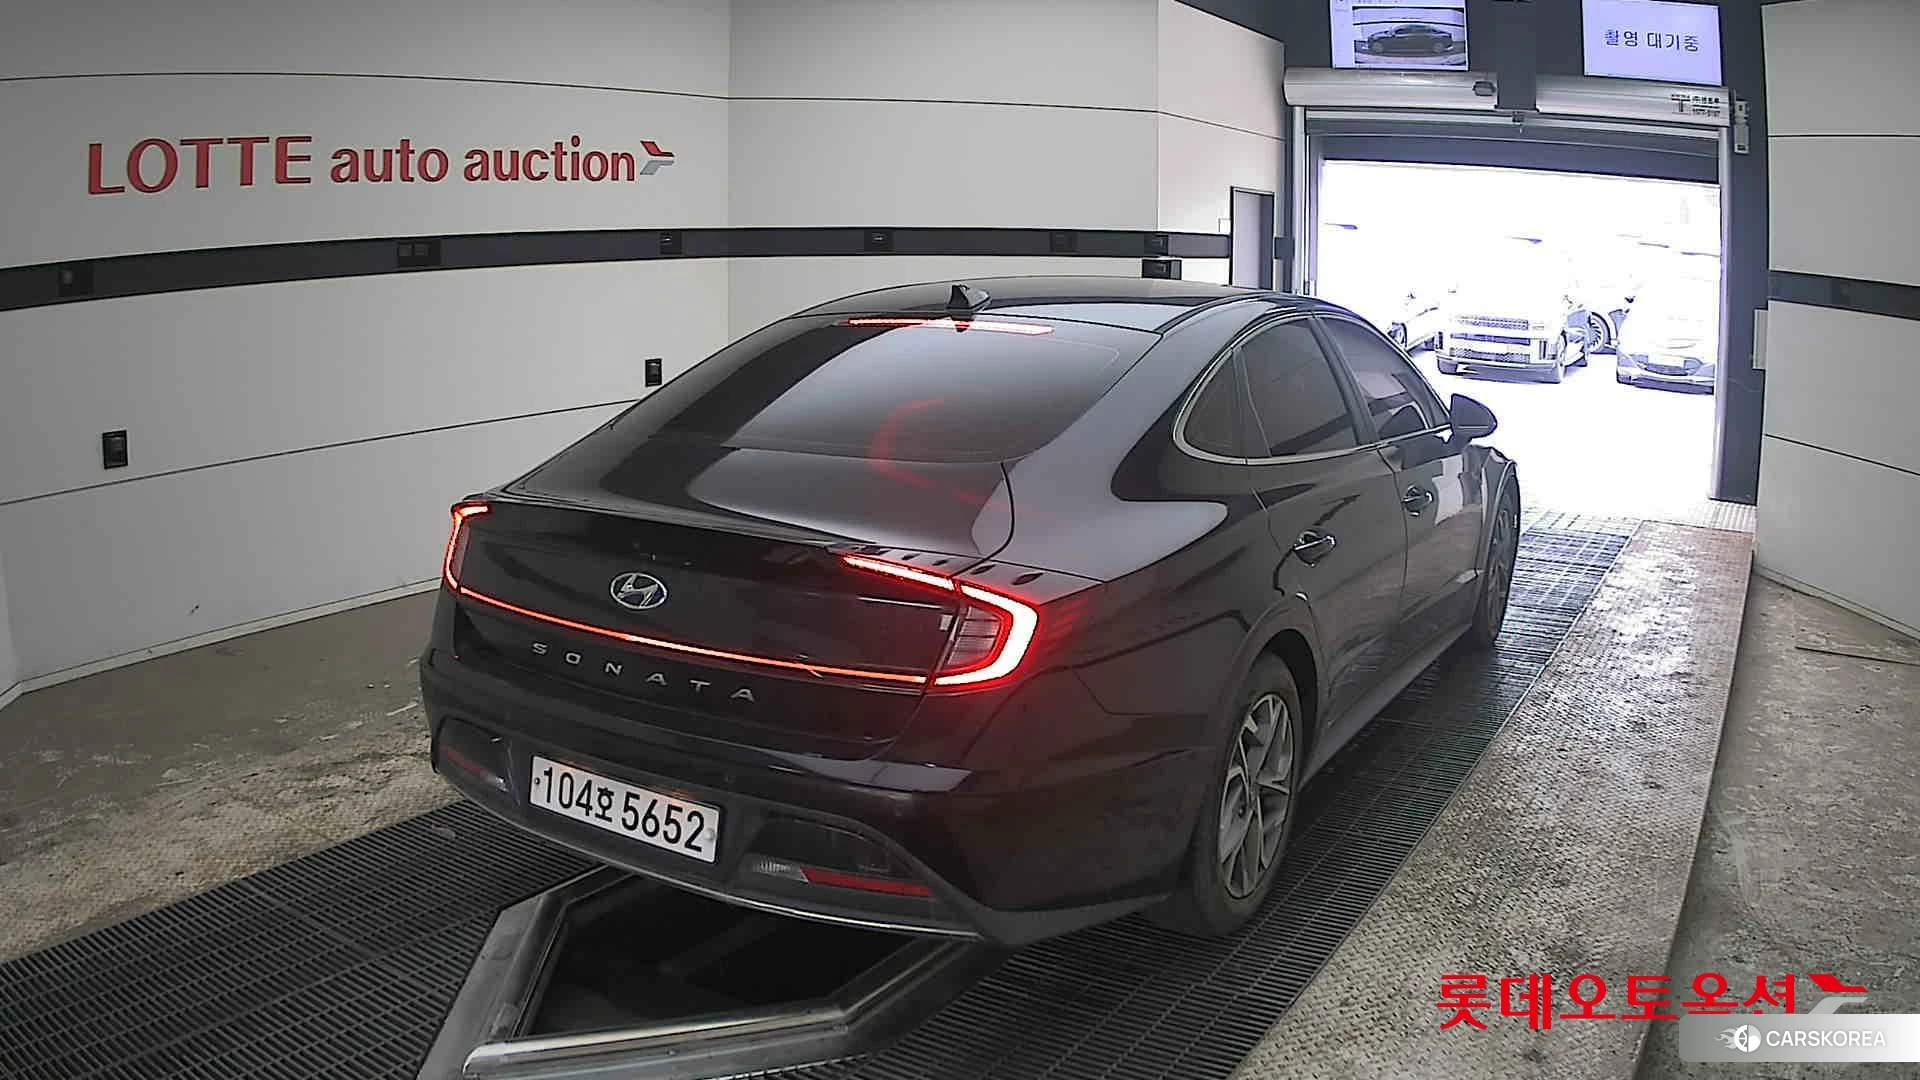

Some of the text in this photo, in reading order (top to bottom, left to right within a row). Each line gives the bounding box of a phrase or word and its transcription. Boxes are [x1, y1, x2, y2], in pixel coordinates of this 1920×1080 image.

[1604, 29, 1699, 52] 촬영 대기중
[88, 134, 636, 195] LOTTE auto auction
[532, 641, 755, 702] SONATA
[543, 767, 705, 853] 104호 5652
